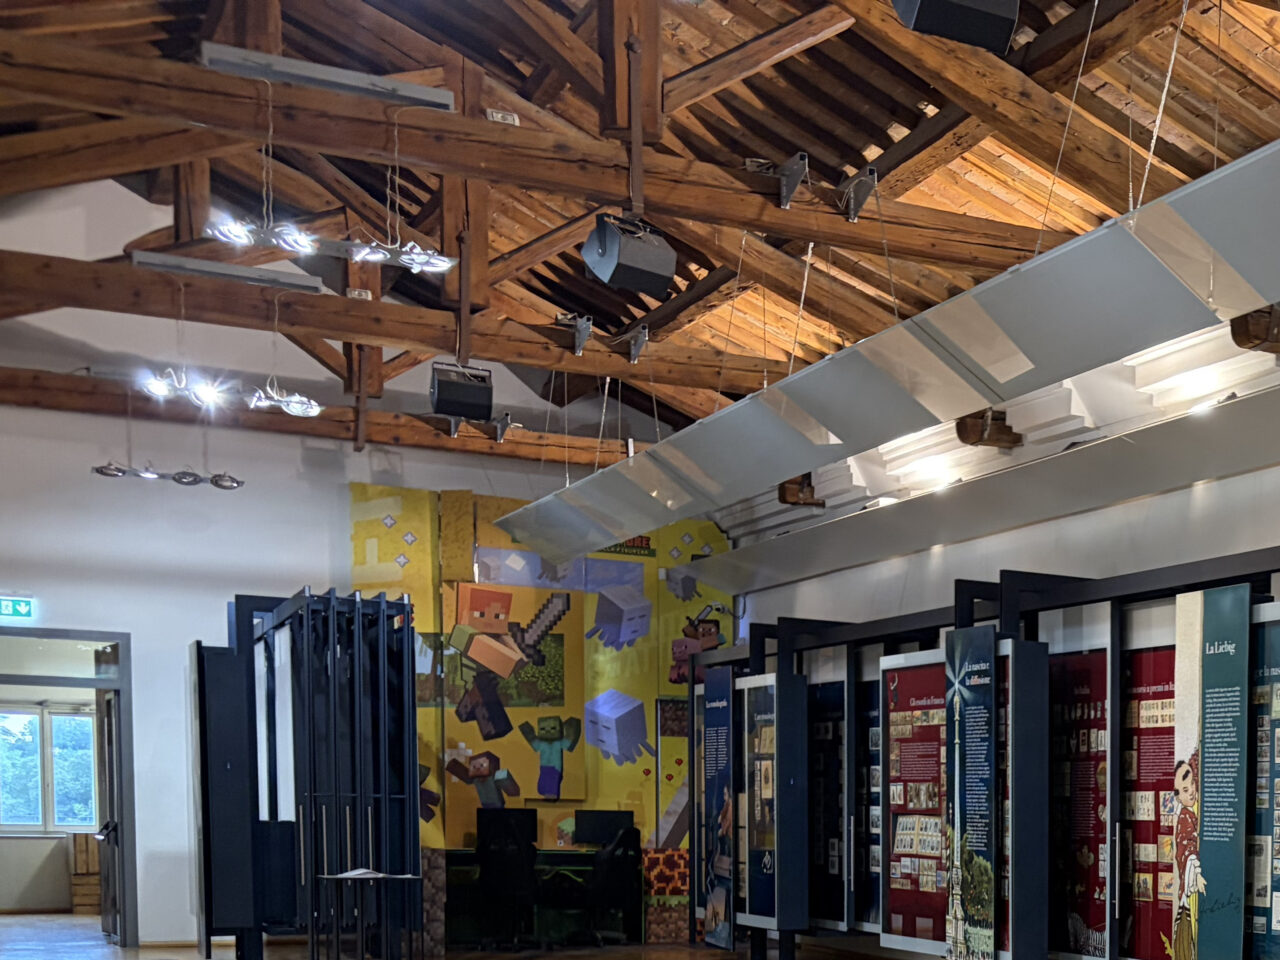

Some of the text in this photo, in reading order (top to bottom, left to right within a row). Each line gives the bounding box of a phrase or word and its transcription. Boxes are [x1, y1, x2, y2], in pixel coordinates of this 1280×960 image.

[1206, 640, 1236, 655] La Liebig
[1264, 664, 1270, 676] la
